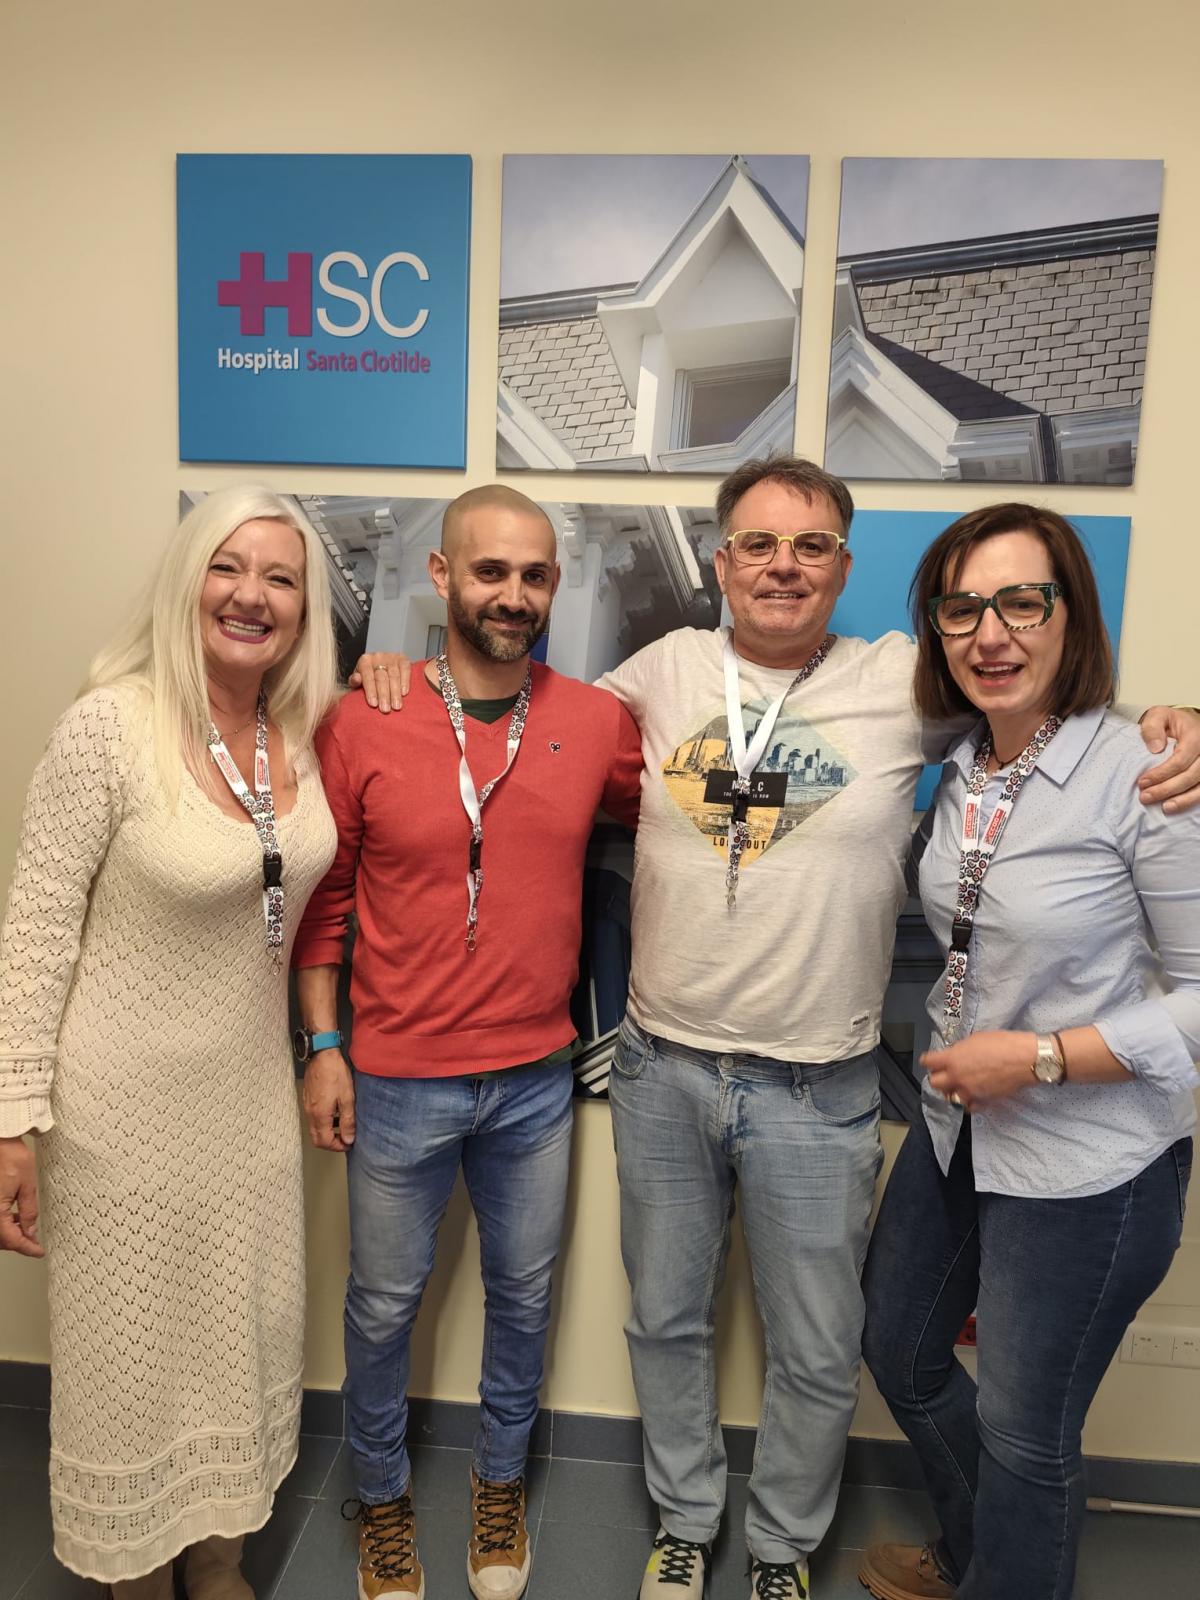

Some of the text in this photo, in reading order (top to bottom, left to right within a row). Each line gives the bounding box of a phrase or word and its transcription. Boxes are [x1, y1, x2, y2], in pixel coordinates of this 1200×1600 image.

[218, 251, 430, 338] HSC
[218, 348, 431, 374] Hospital Santa Clotilde
